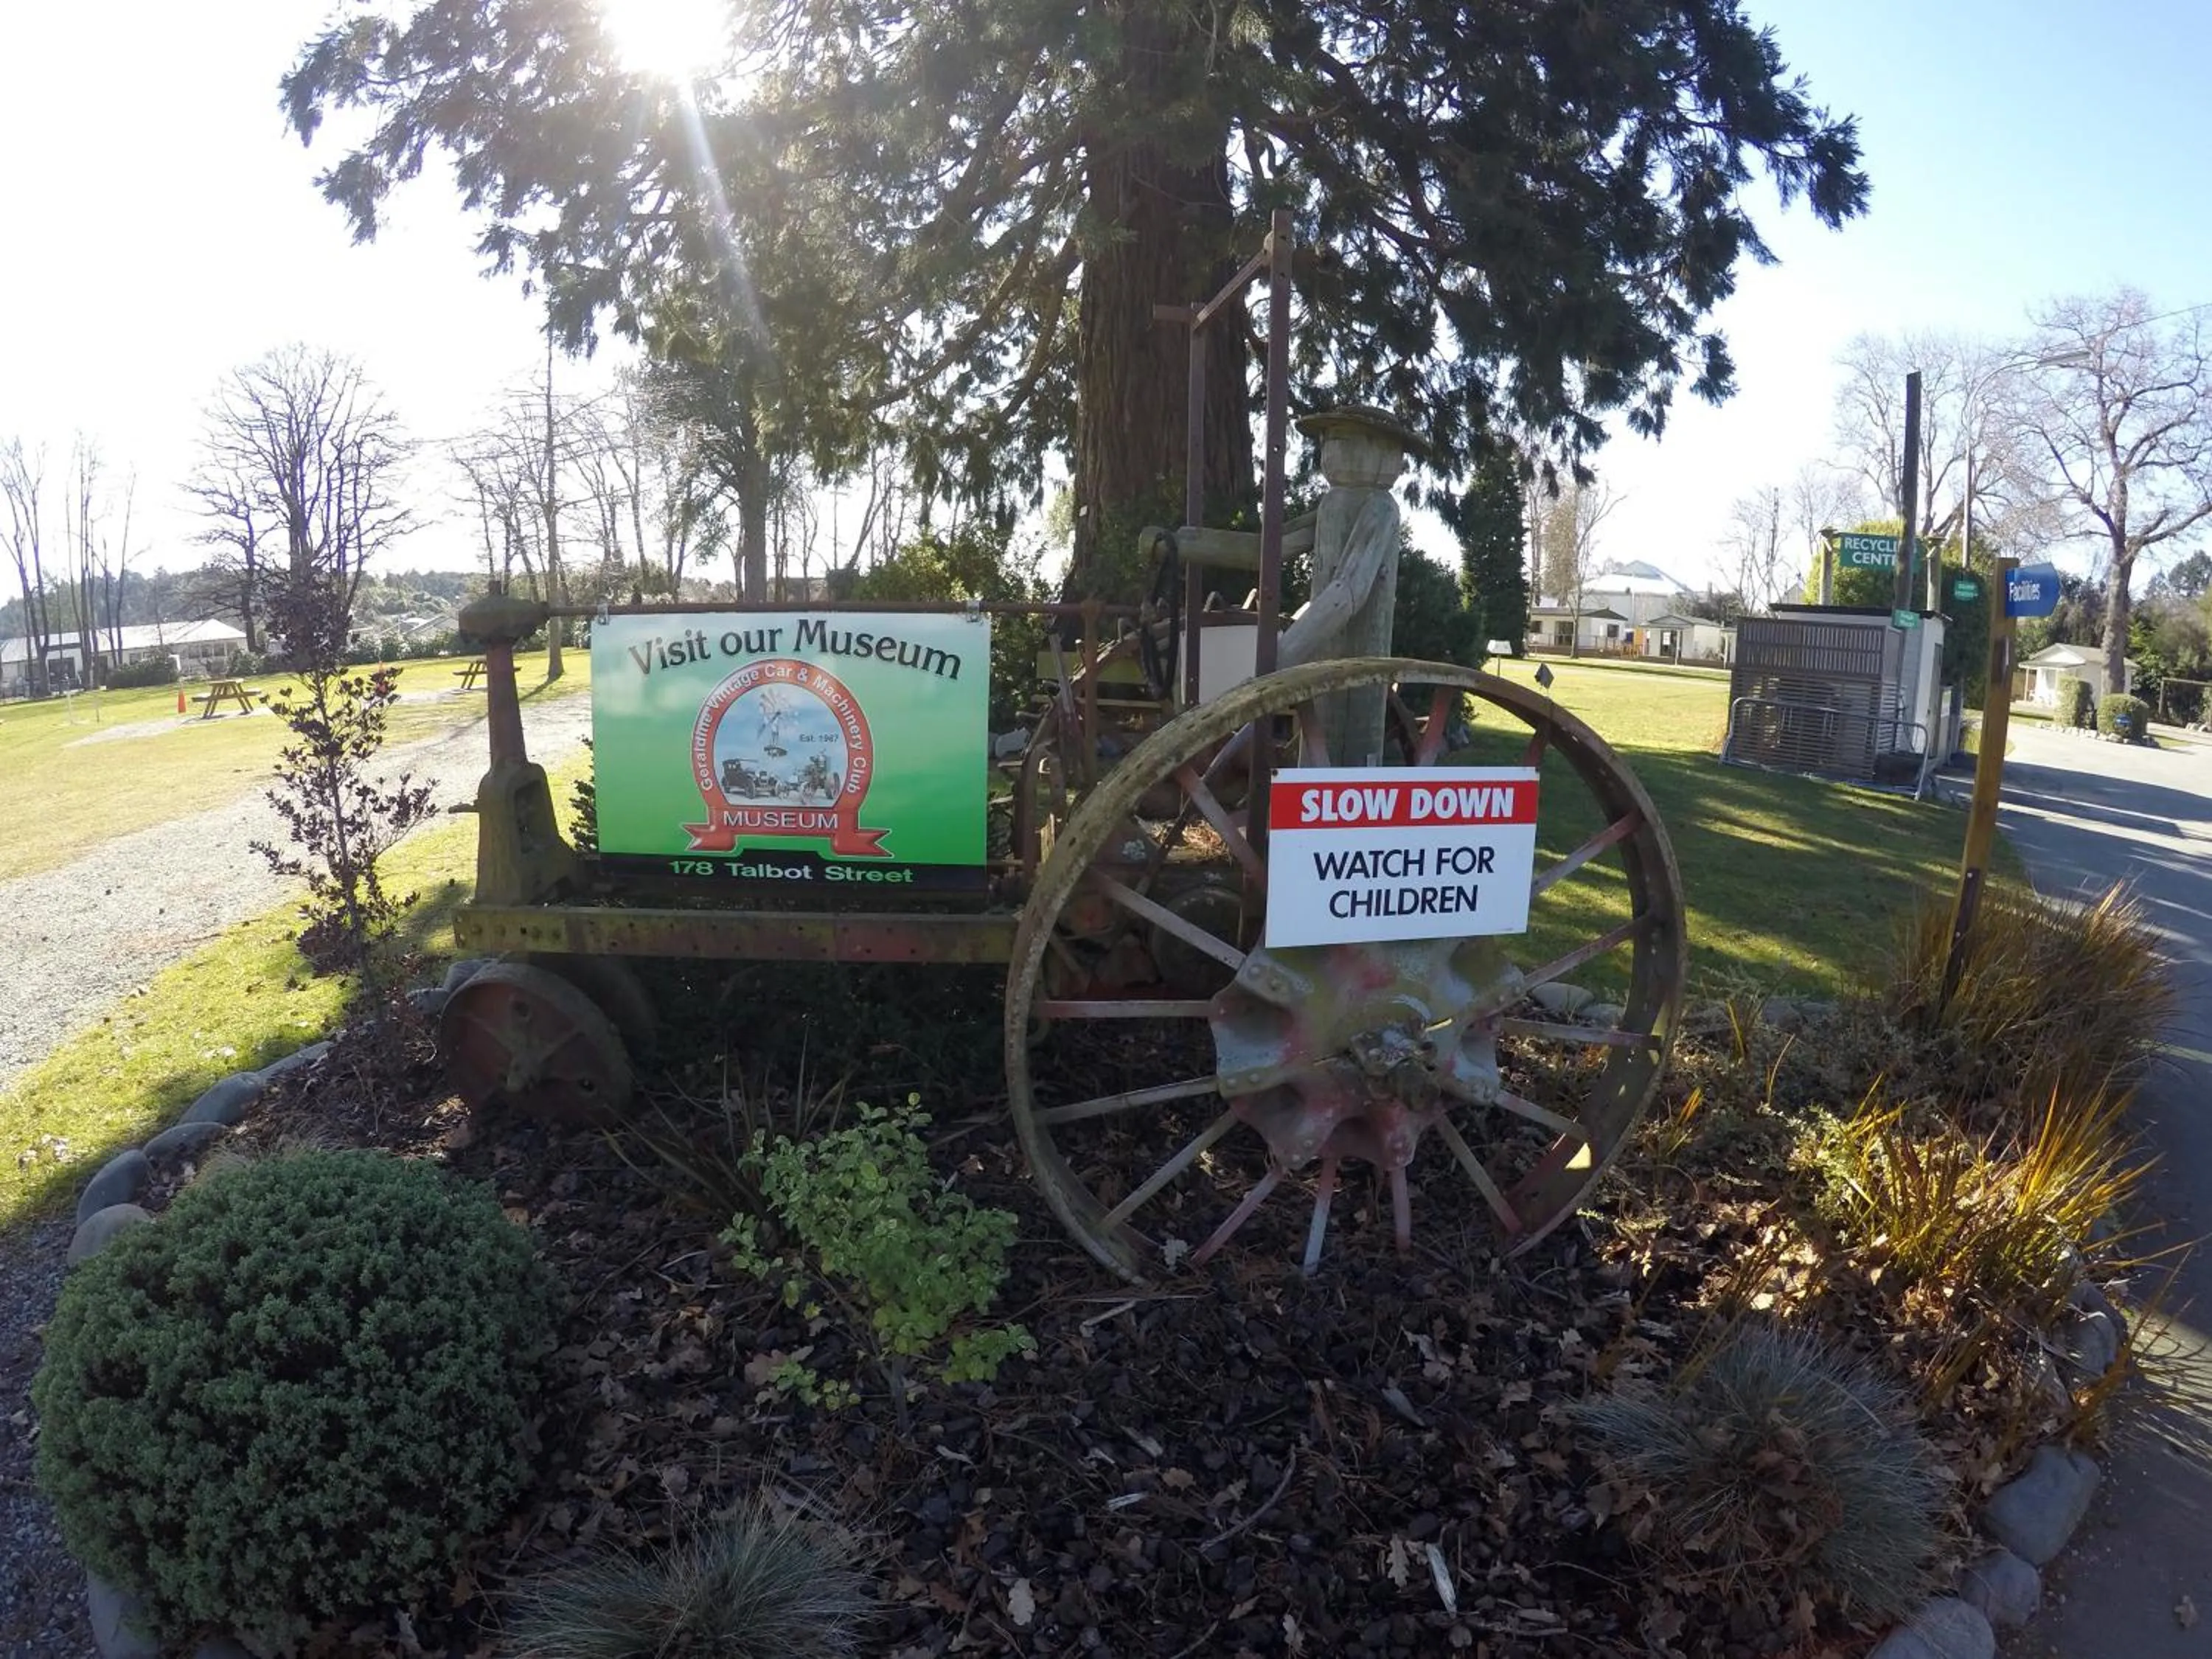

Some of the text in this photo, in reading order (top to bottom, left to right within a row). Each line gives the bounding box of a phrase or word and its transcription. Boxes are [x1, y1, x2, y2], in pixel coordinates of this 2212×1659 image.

[1844, 536, 1917, 554] RECYCLI
[1851, 552, 1897, 566] CENT
[629, 619, 961, 680] Visit our Museum
[695, 664, 866, 793] Geraldine Vintage Car & Machinery Club
[723, 811, 839, 830] MUSEUM
[1301, 787, 1514, 822] SLOW DOWN
[669, 860, 914, 883] 178 Talbot Street
[1313, 846, 1495, 881] WATCH FOR
[1329, 885, 1478, 919] CHILDREN
